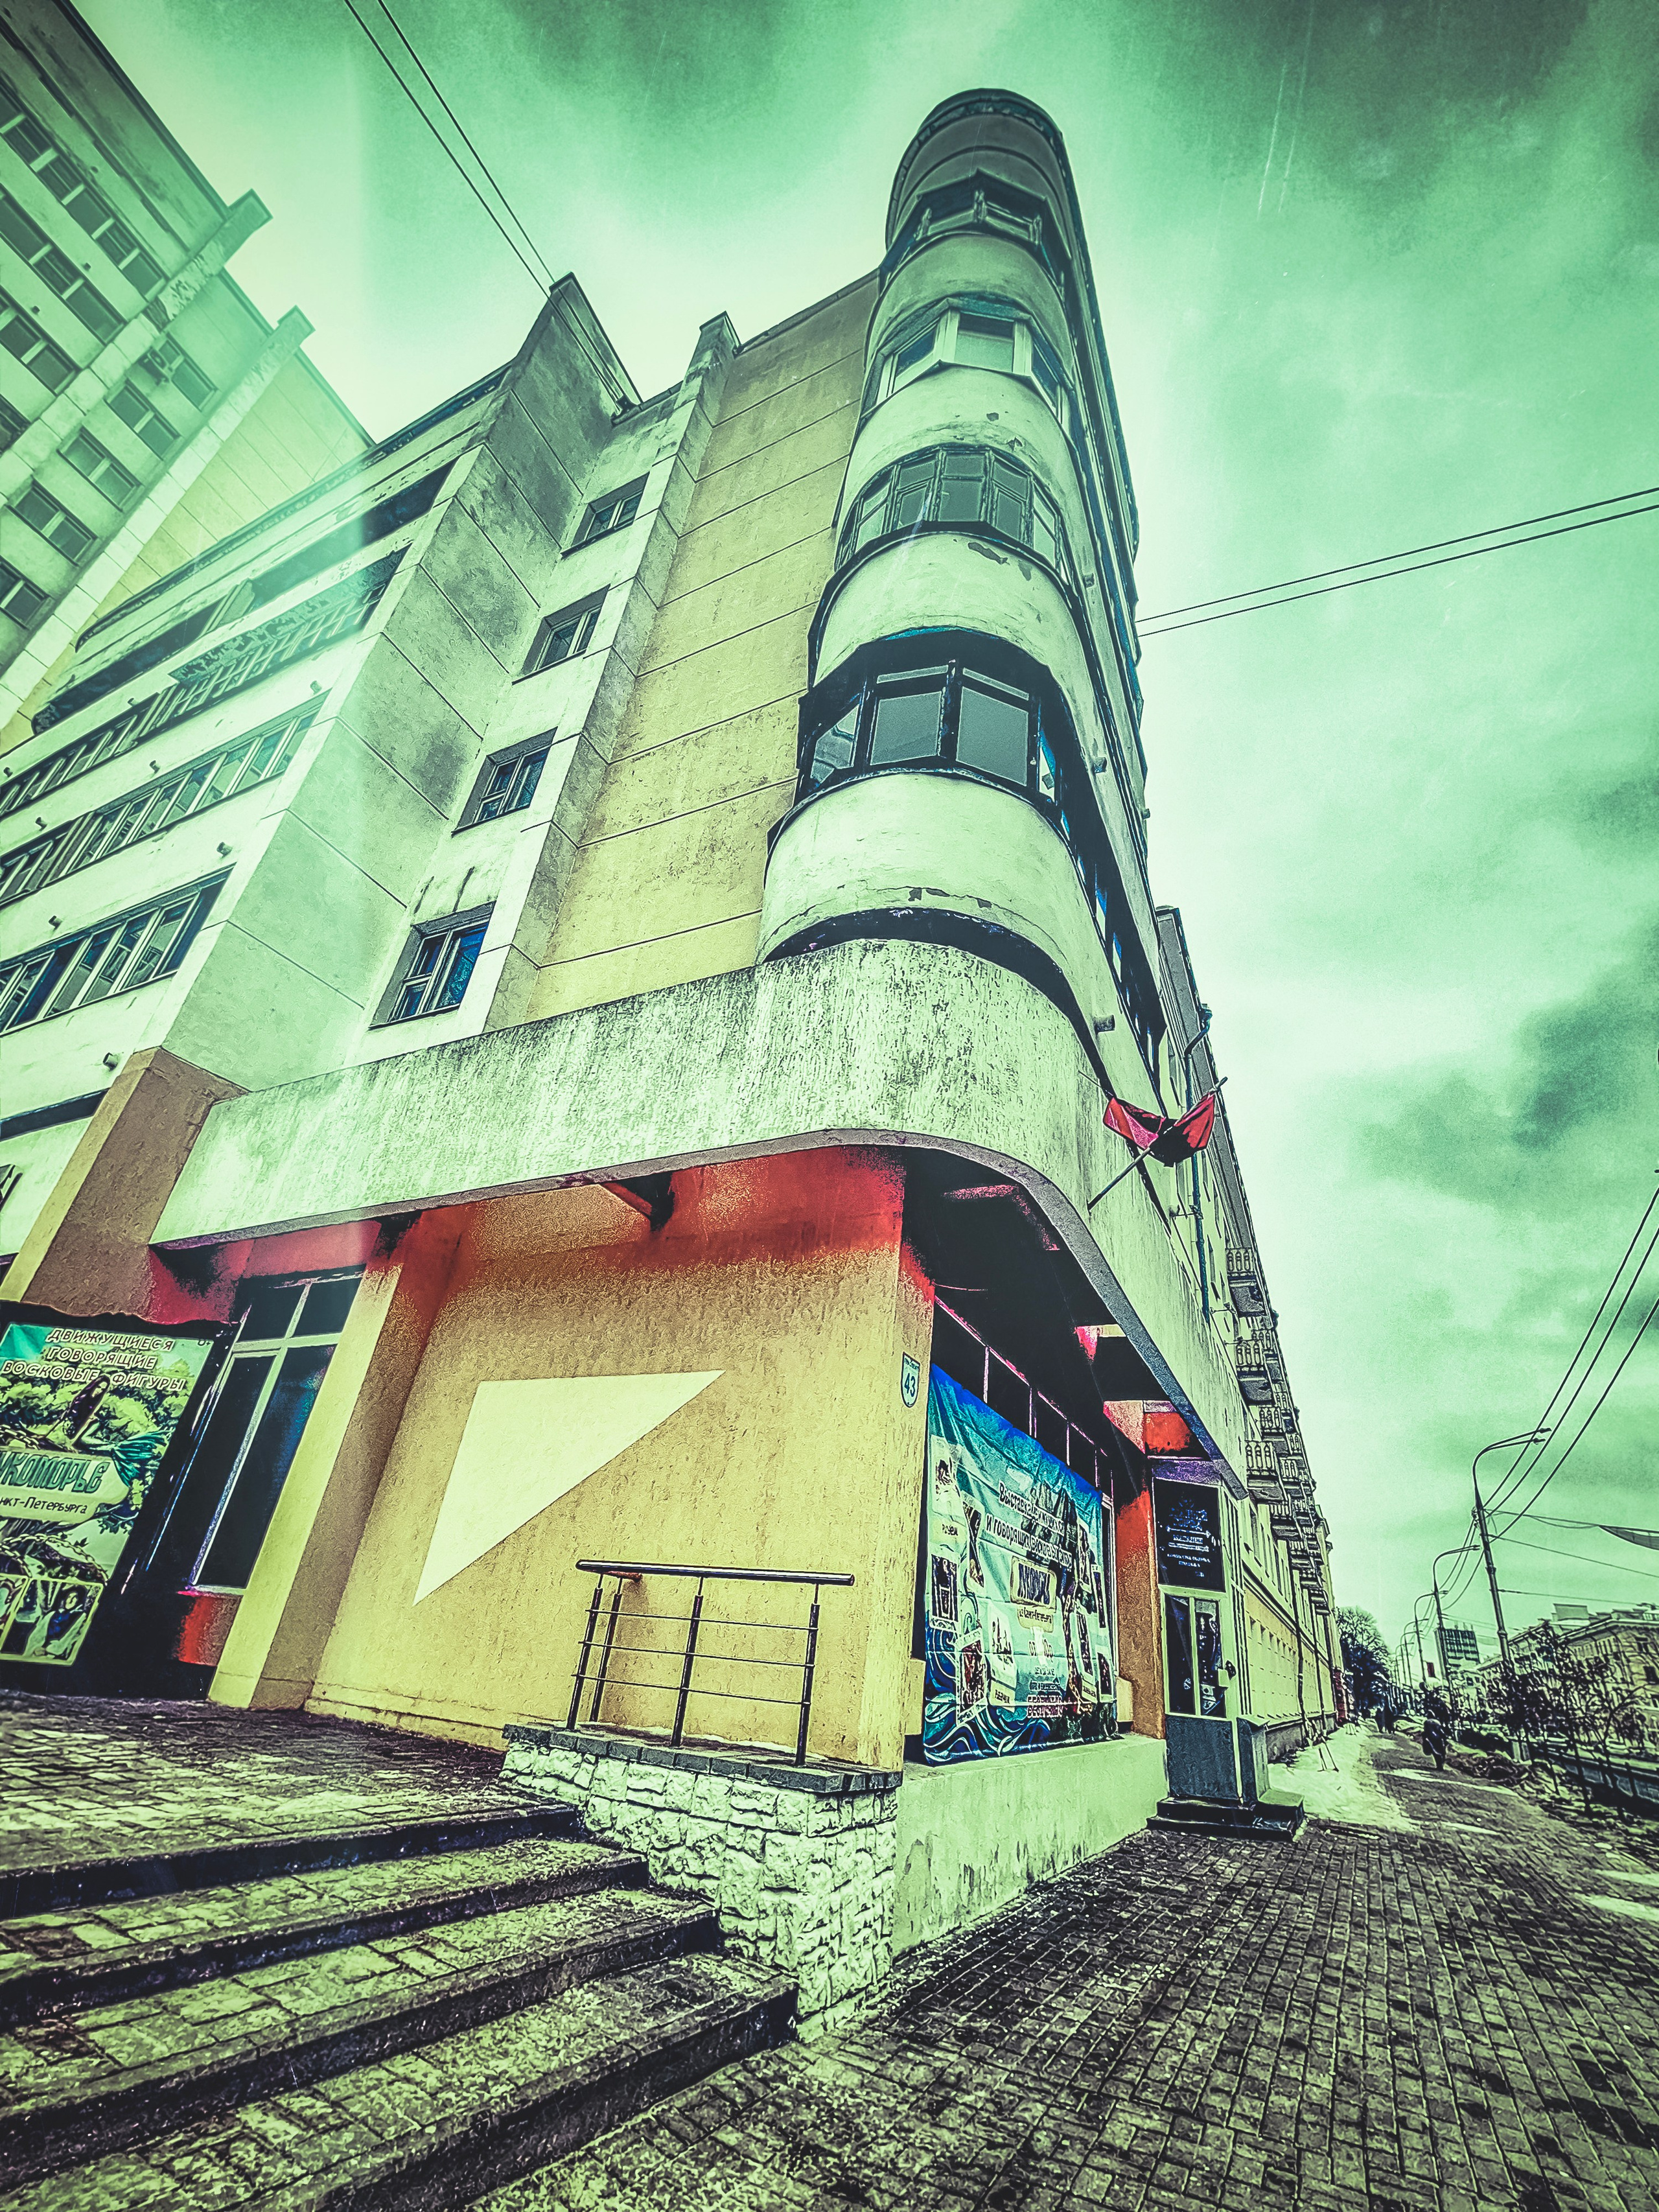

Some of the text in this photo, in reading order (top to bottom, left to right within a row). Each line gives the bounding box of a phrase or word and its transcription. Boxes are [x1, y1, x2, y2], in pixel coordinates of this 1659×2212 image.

[47, 1329, 174, 1351] ДВИЖУЩИЕСЯ
[47, 1347, 156, 1369] ГОВОРЯЩИЕ
[3, 1361, 185, 1391] ВОСКОВЫЕ ФИГУРЫ
[904, 1373, 916, 1397] 43
